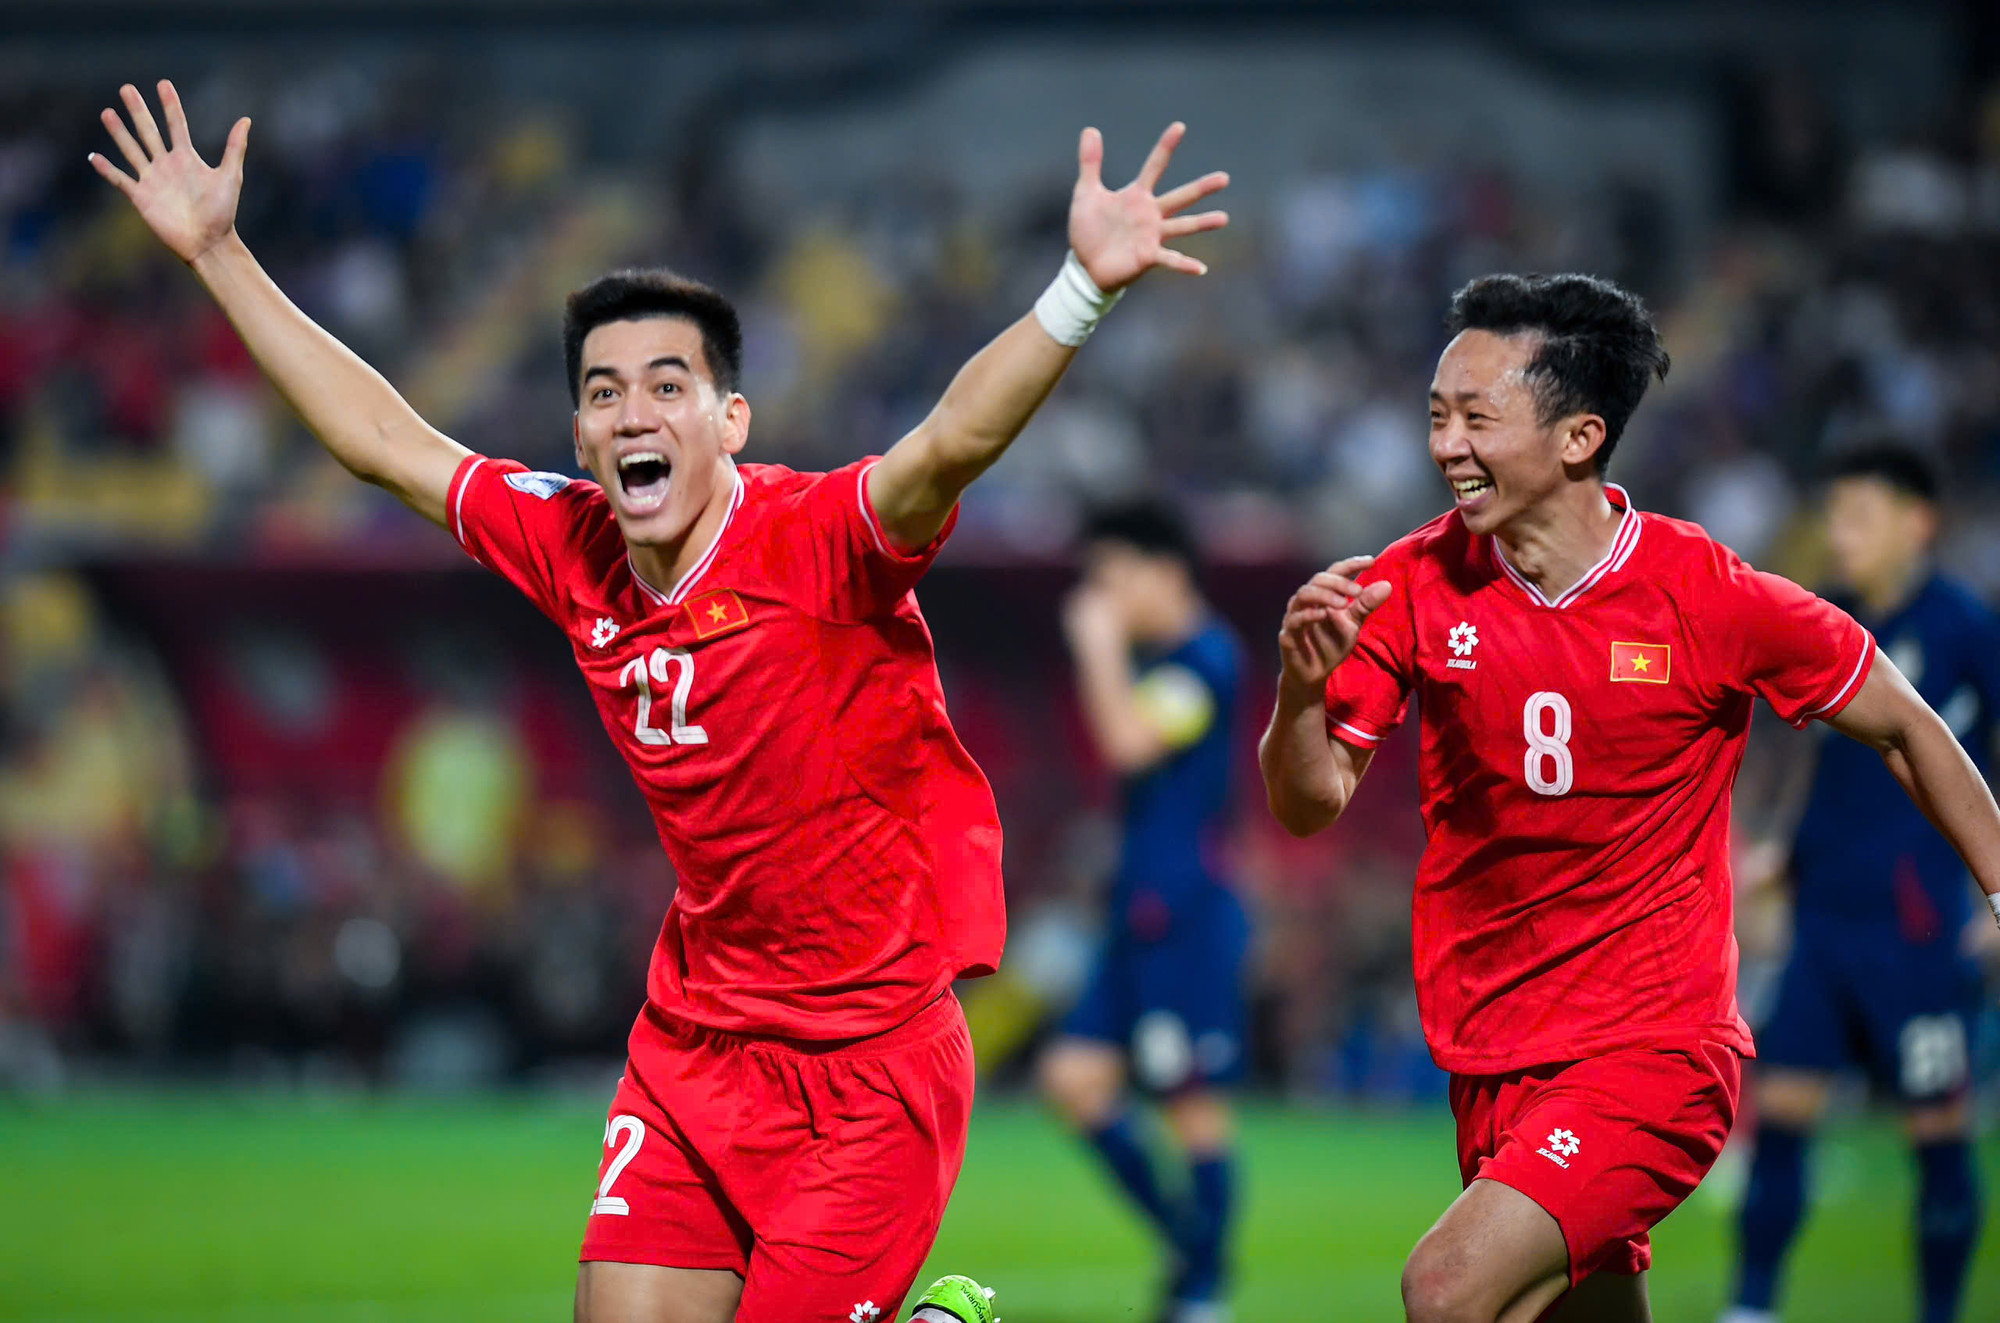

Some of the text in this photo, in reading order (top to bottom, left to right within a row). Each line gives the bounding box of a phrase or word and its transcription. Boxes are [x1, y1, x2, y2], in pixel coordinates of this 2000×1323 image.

[620, 647, 709, 745] 22
[1523, 691, 1573, 796] 8
[590, 1115, 646, 1216] 2
